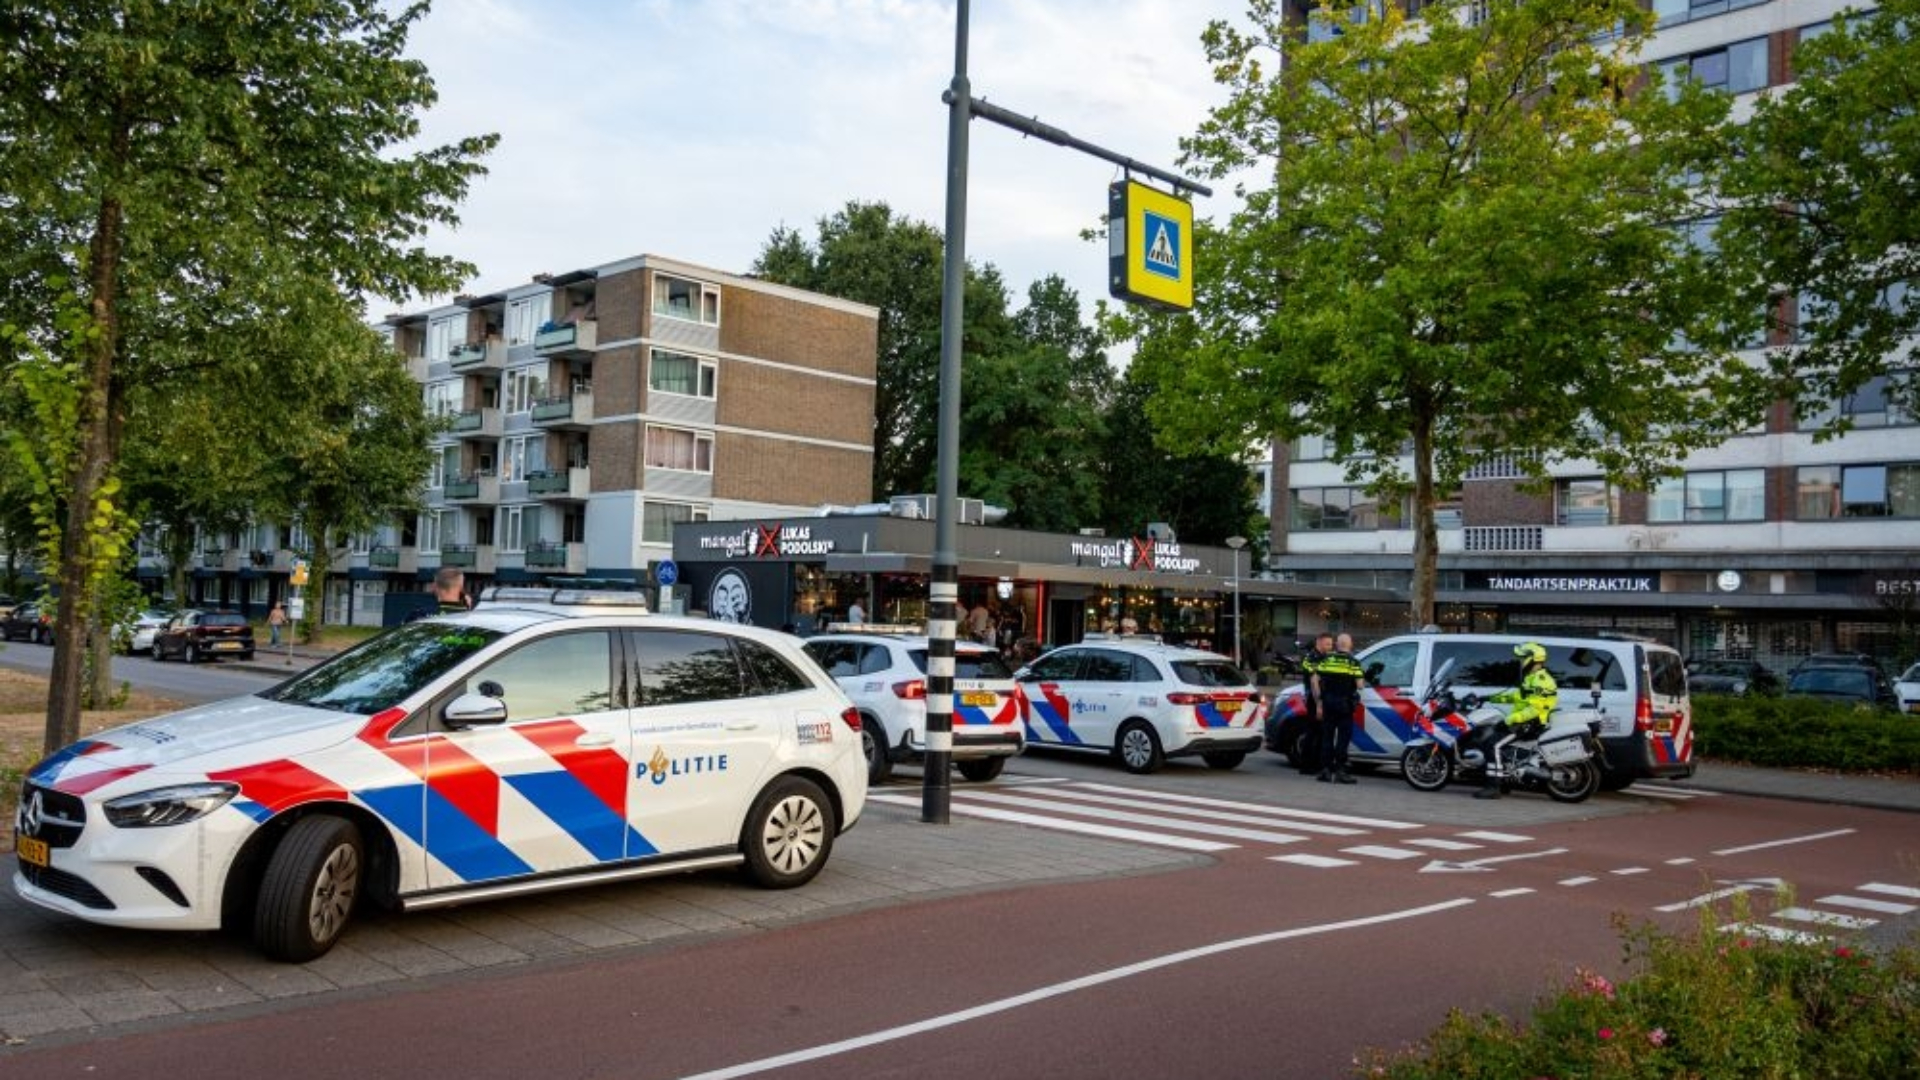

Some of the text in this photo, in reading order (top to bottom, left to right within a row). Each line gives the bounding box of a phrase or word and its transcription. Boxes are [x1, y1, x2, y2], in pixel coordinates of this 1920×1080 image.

[781, 527, 810, 540] LUKAS
[1154, 542, 1181, 556] LUKAS
[1488, 577, 1650, 591] TANDARTSENPRAKTIJK
[814, 722, 831, 735] 112
[636, 754, 728, 785] POLITIE
